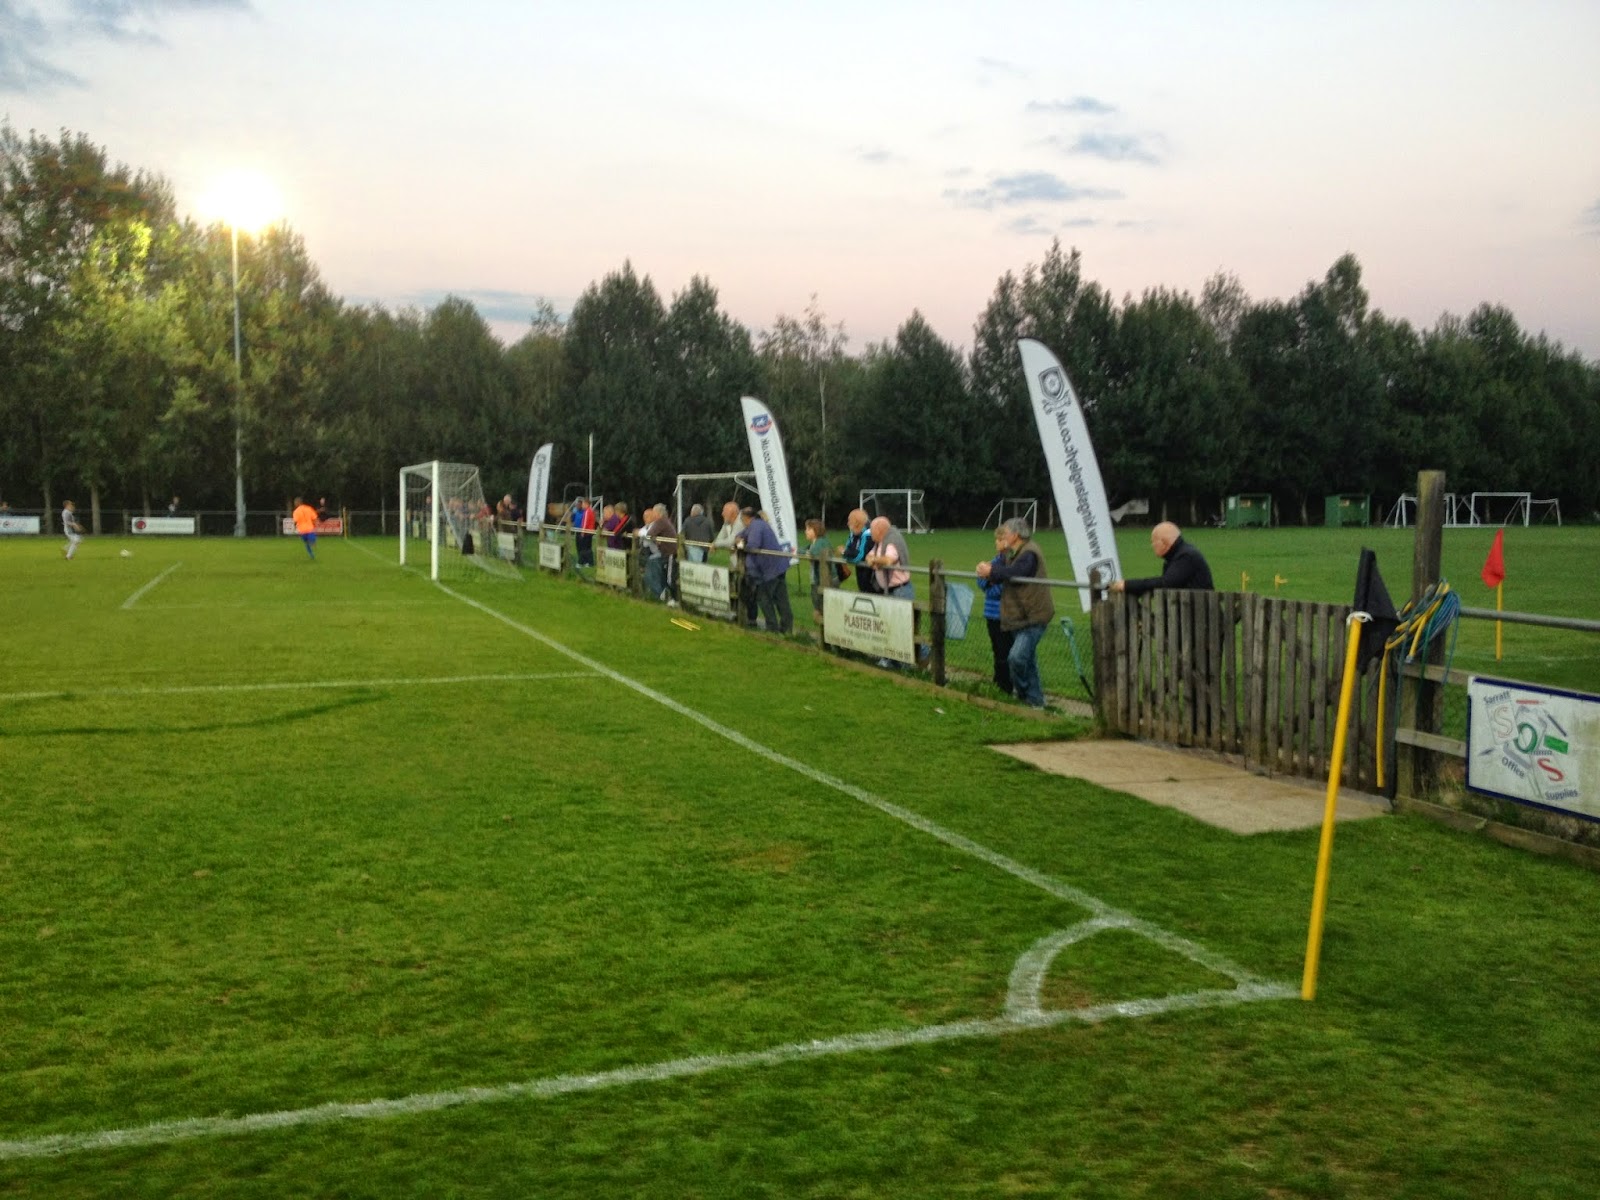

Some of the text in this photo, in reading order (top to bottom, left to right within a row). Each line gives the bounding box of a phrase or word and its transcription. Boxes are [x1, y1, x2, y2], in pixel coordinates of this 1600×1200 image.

[844, 614, 872, 631] PLASTER
[1483, 690, 1510, 704] Sarratt
[1501, 756, 1525, 778] Office
[1545, 788, 1578, 800] Supplies
